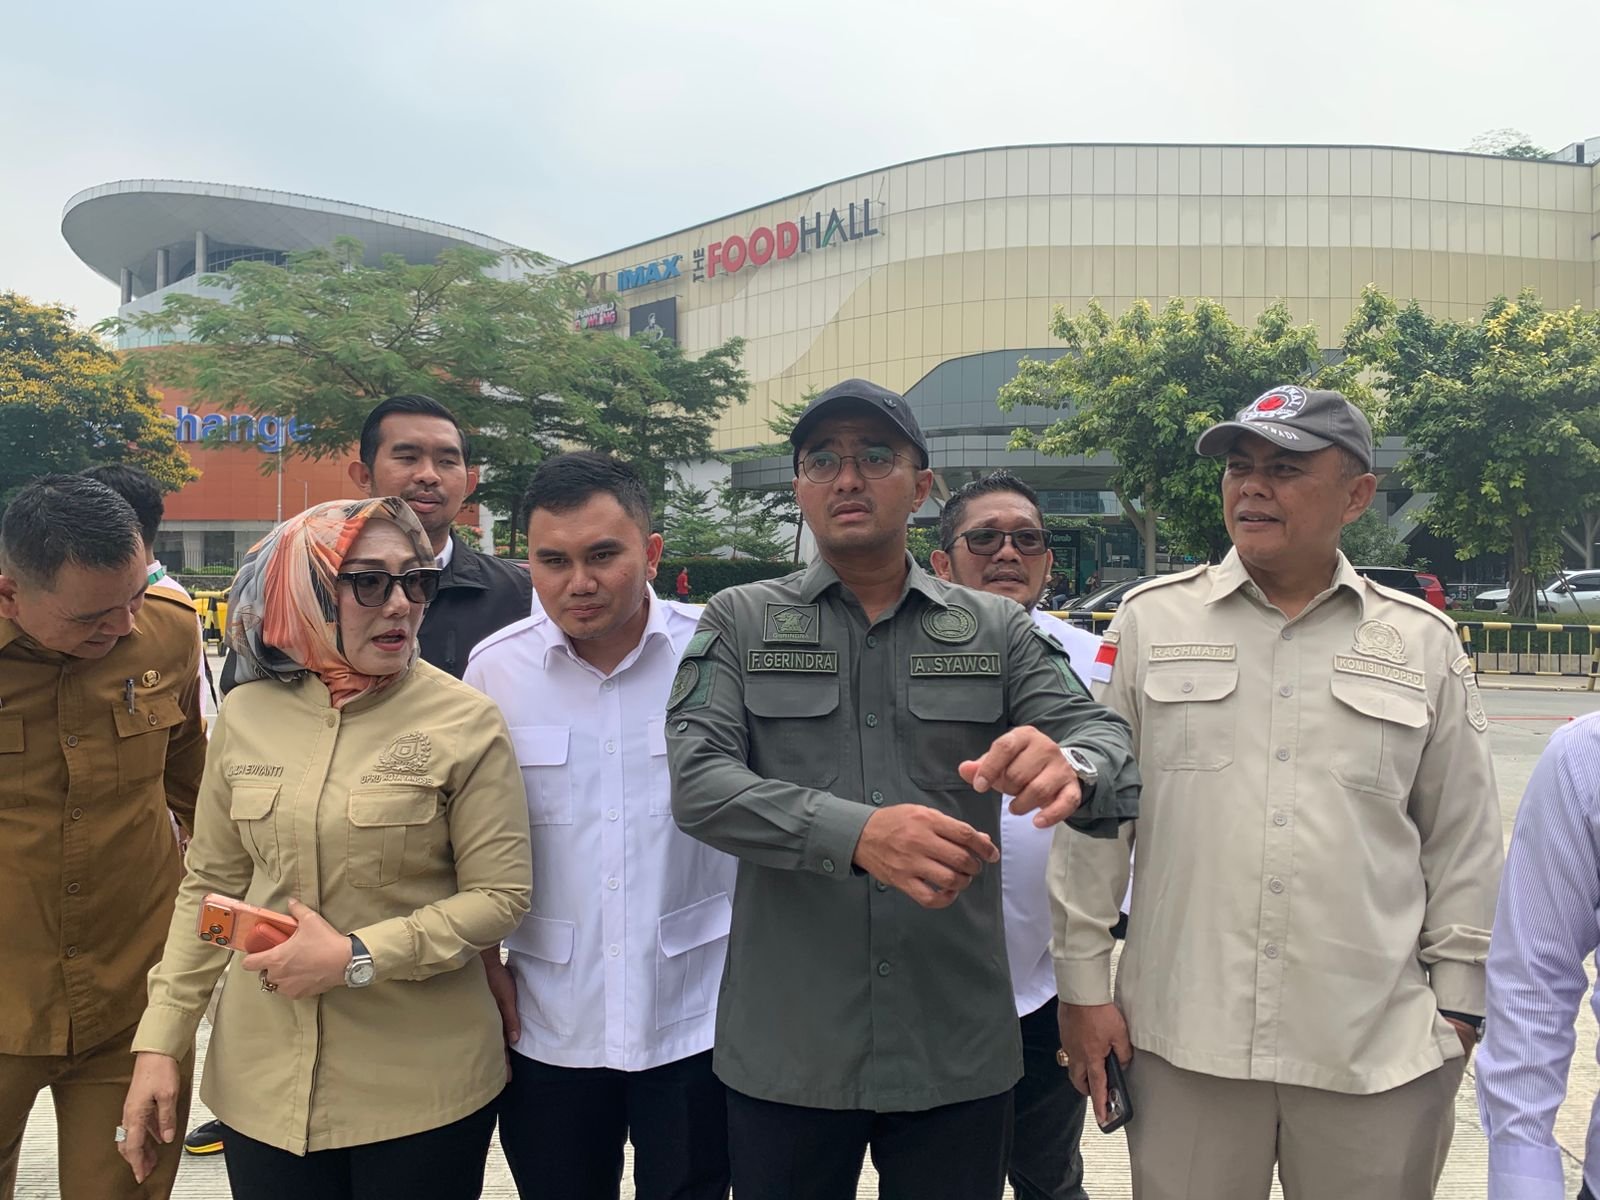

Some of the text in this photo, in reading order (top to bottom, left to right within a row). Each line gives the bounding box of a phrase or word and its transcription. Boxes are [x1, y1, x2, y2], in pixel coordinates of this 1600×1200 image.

[617, 255, 681, 292] IMAX
[693, 247, 704, 283] THE
[161, 405, 316, 453] hange
[763, 652, 834, 670] GERINDRA
[934, 655, 996, 673] SYAWQI
[1339, 658, 1378, 674] KOMISI
